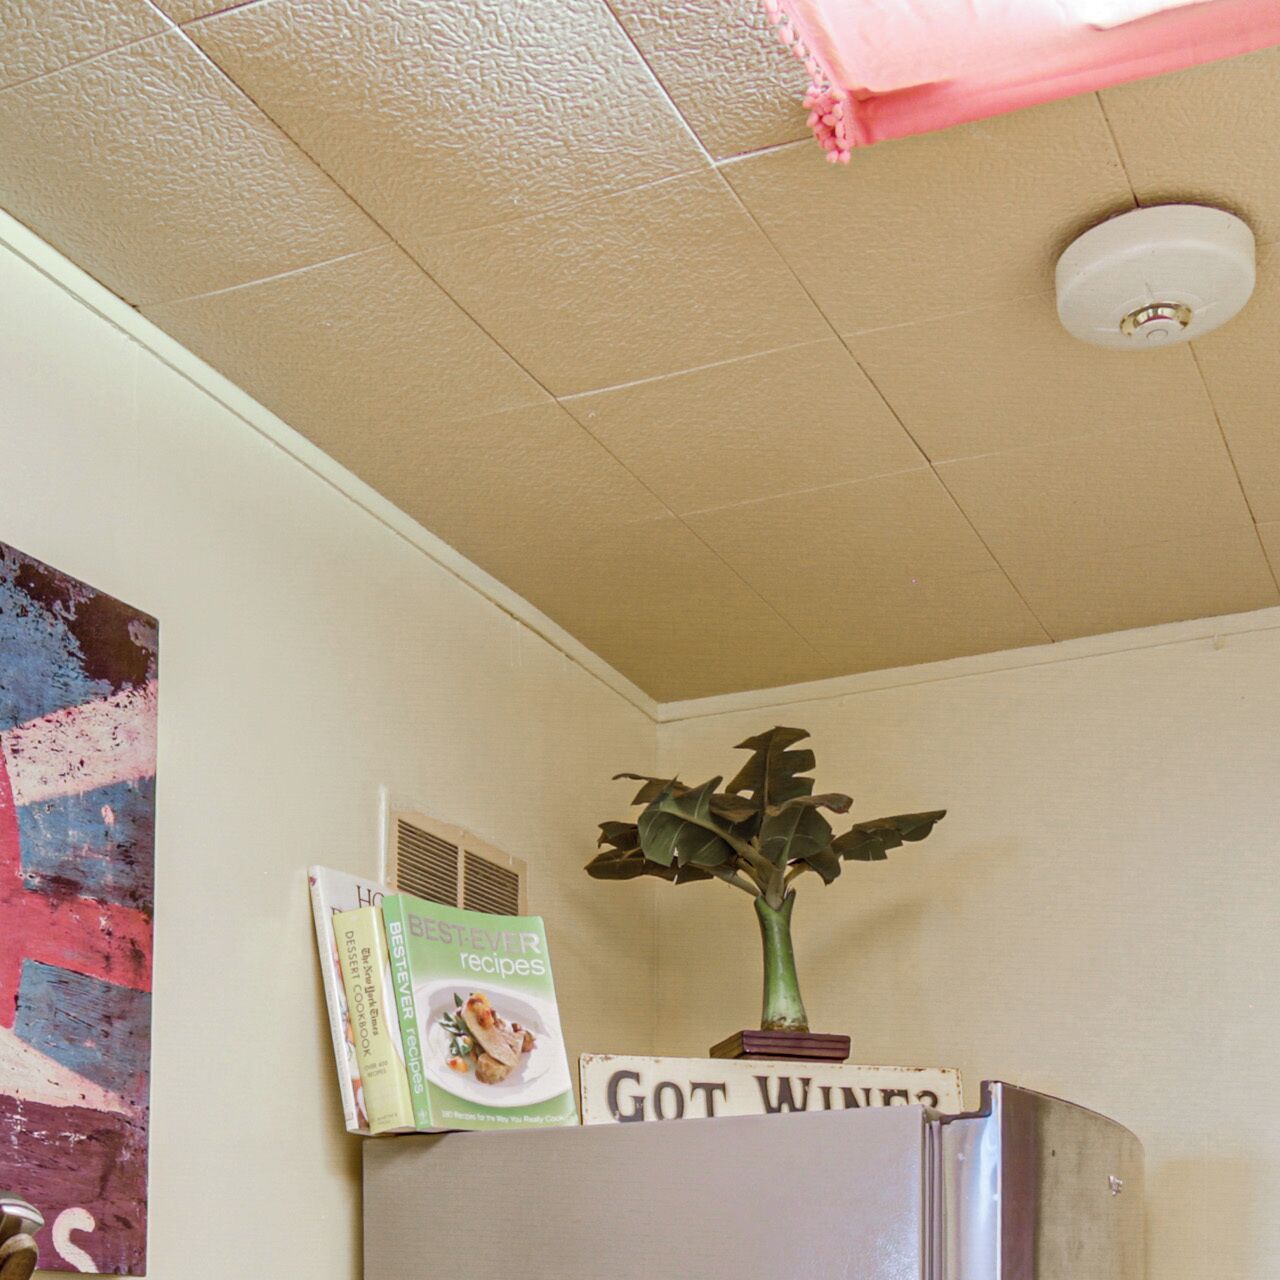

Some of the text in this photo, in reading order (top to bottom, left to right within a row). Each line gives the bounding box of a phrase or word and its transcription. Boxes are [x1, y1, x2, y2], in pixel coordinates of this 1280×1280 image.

[344, 930, 372, 1057] DESSERT COOKBOOK
[460, 952, 545, 978] recipes
[406, 1028, 425, 1095] recipes
[606, 1070, 727, 1123] GOT
